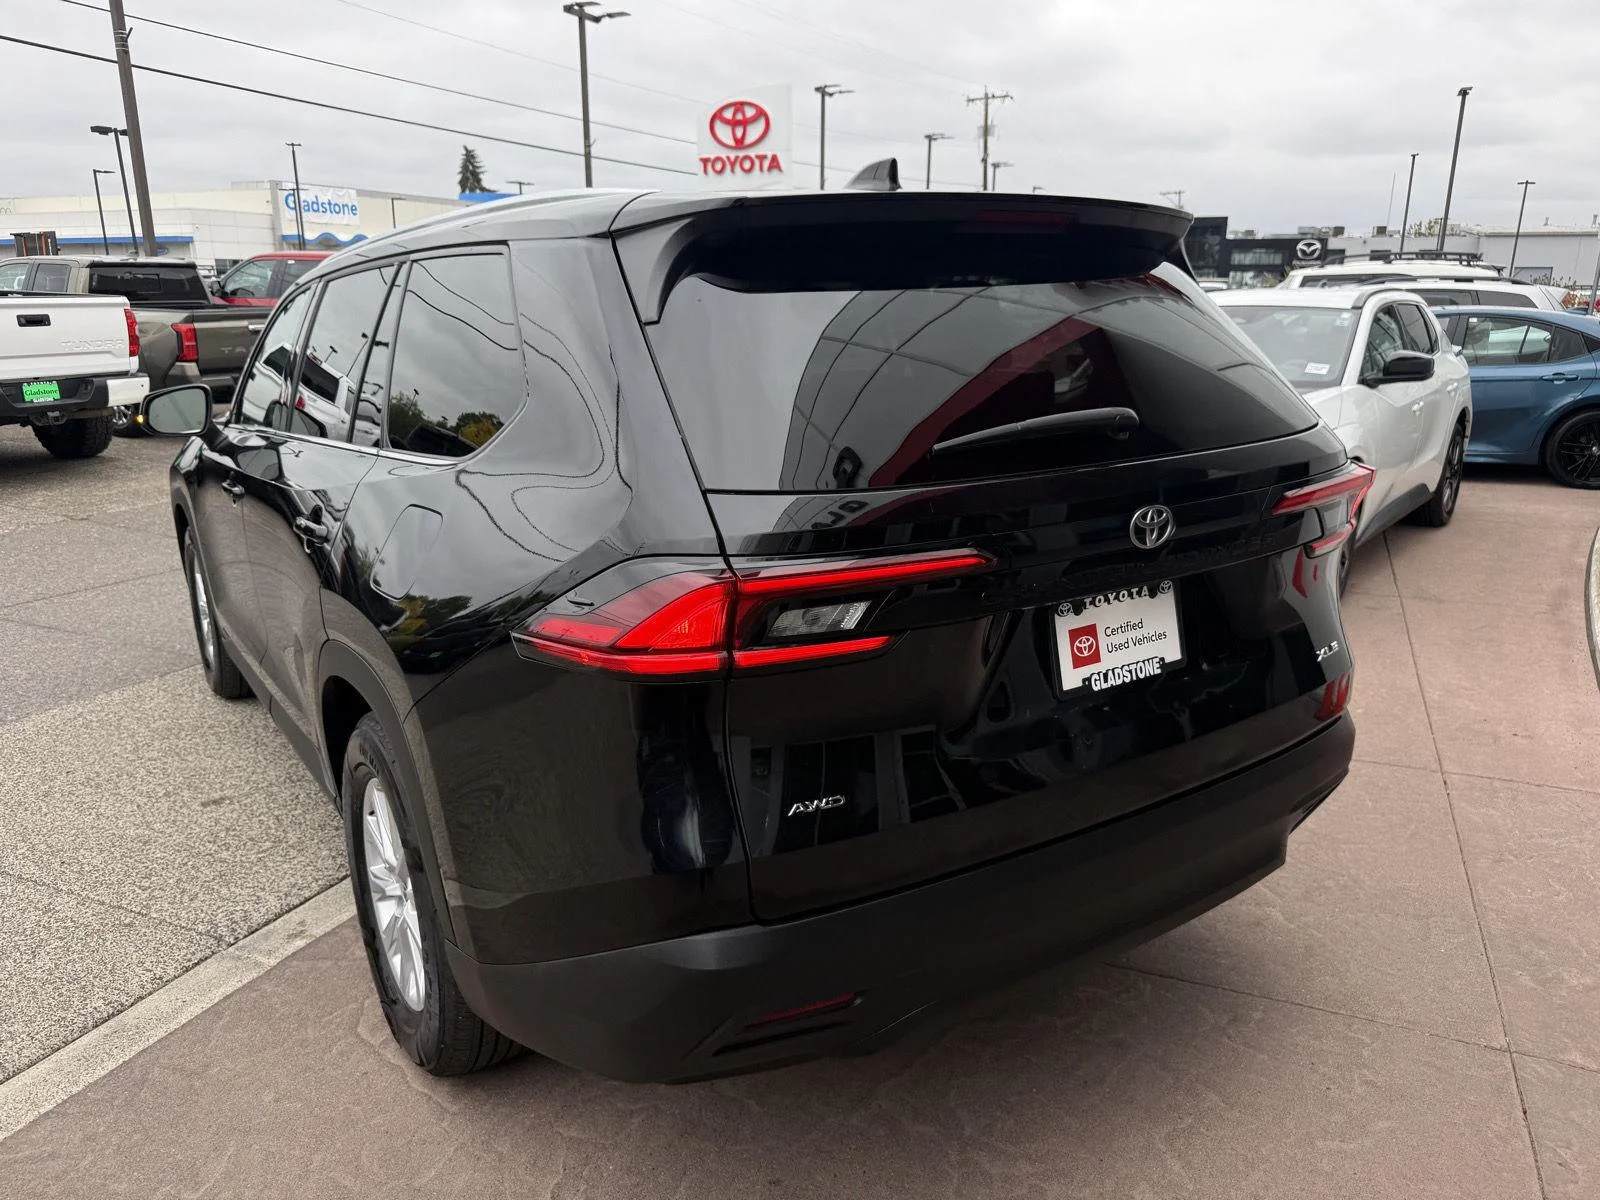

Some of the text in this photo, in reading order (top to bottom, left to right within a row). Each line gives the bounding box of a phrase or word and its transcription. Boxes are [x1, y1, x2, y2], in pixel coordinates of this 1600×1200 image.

[699, 154, 783, 176] TOYOTA
[284, 192, 358, 216] Gadstone
[25, 389, 58, 397] Gladstone
[1083, 585, 1150, 610] TOYOTA
[1104, 618, 1144, 638] Certified
[1106, 630, 1168, 654] Used Vehicles
[1315, 640, 1339, 662] XLE
[1091, 657, 1162, 692] GLADSTONE
[787, 795, 846, 817] AWD
